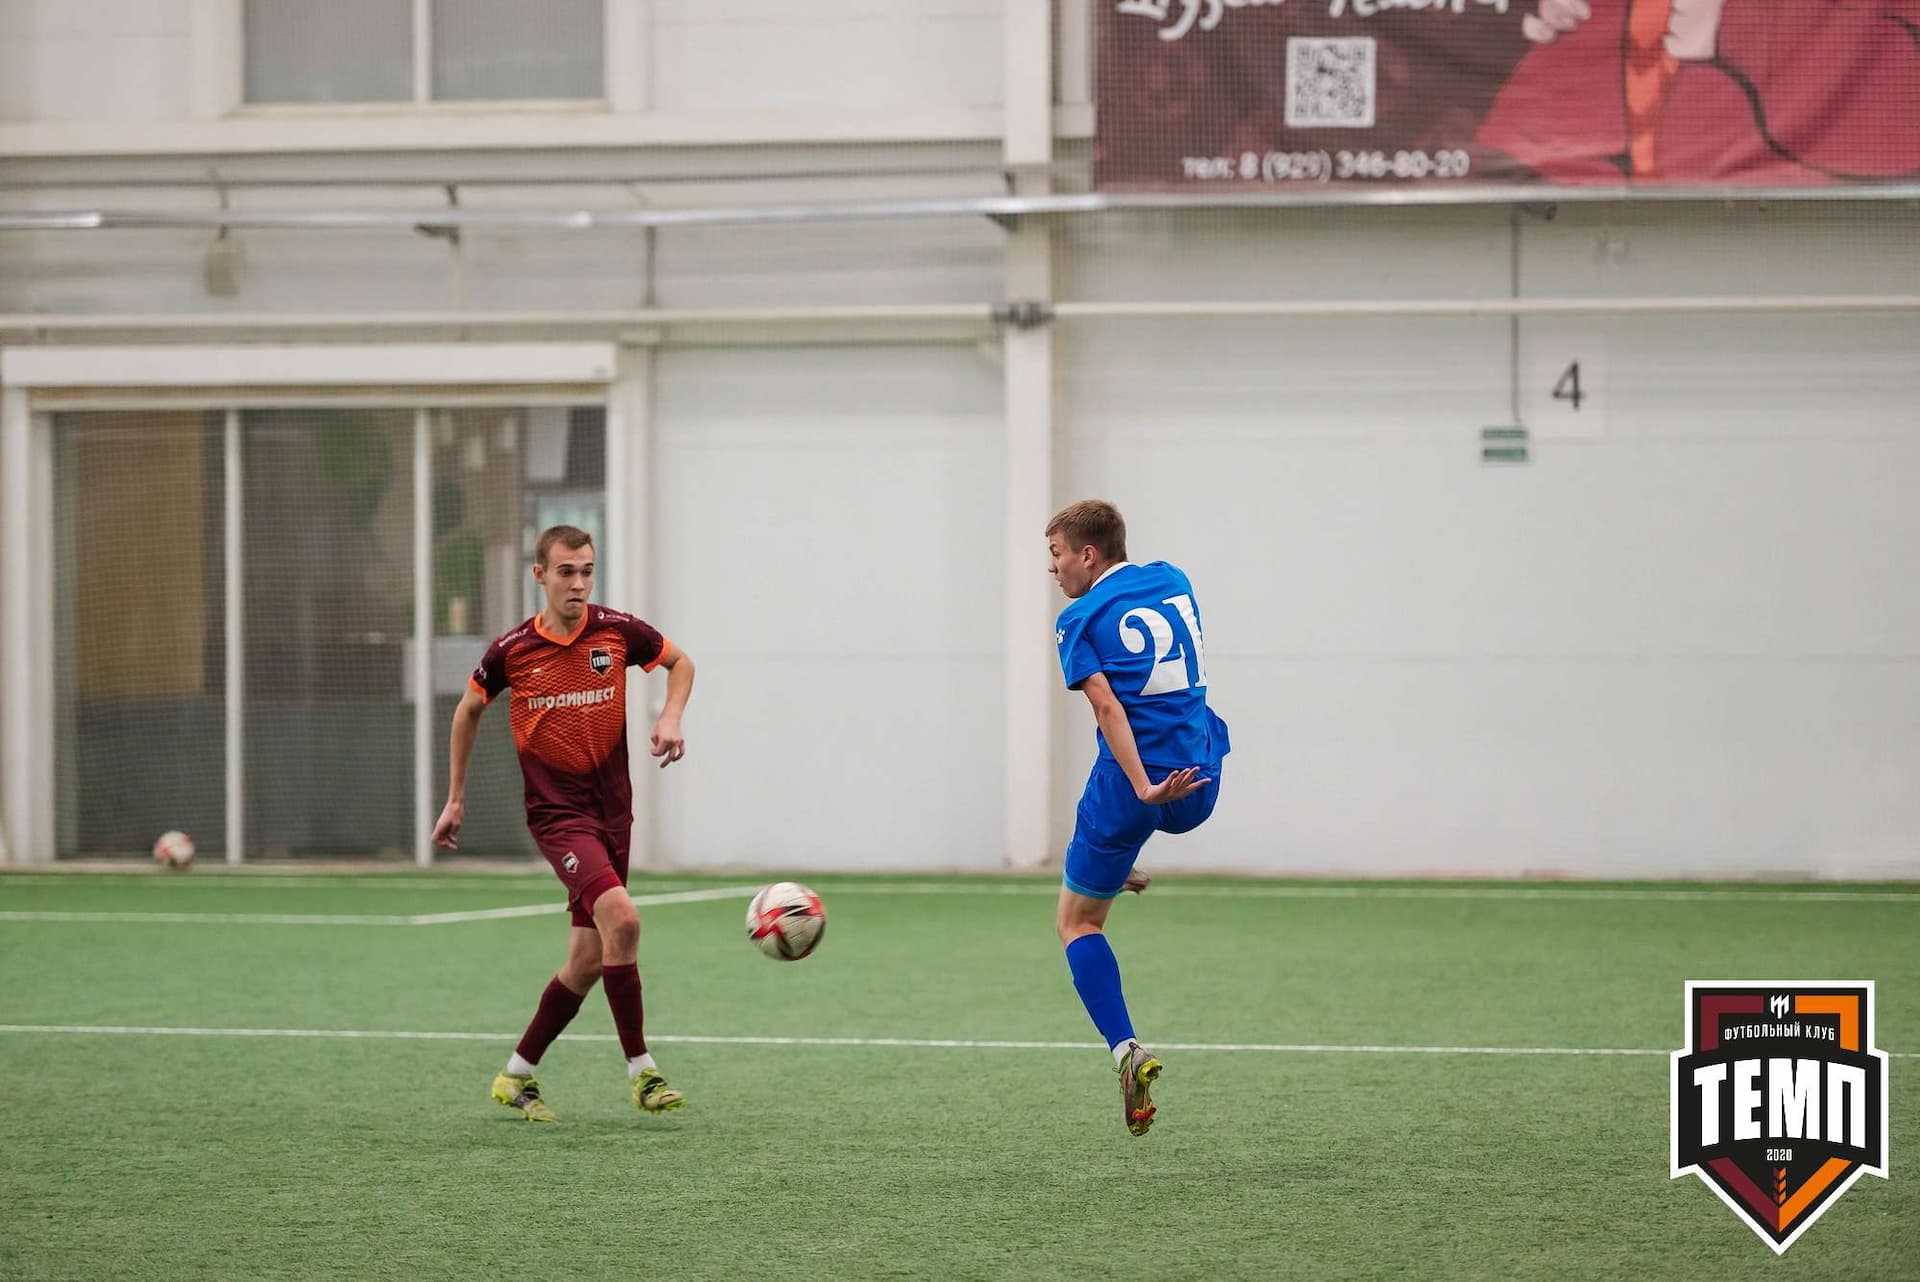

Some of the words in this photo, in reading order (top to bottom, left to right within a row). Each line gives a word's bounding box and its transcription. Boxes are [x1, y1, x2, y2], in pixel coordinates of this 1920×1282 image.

[1240, 151, 1258, 179] 8
[1552, 360, 1586, 412] 4
[1119, 593, 1207, 696] 21
[527, 686, 616, 710] ПРОДИНВЕСТ
